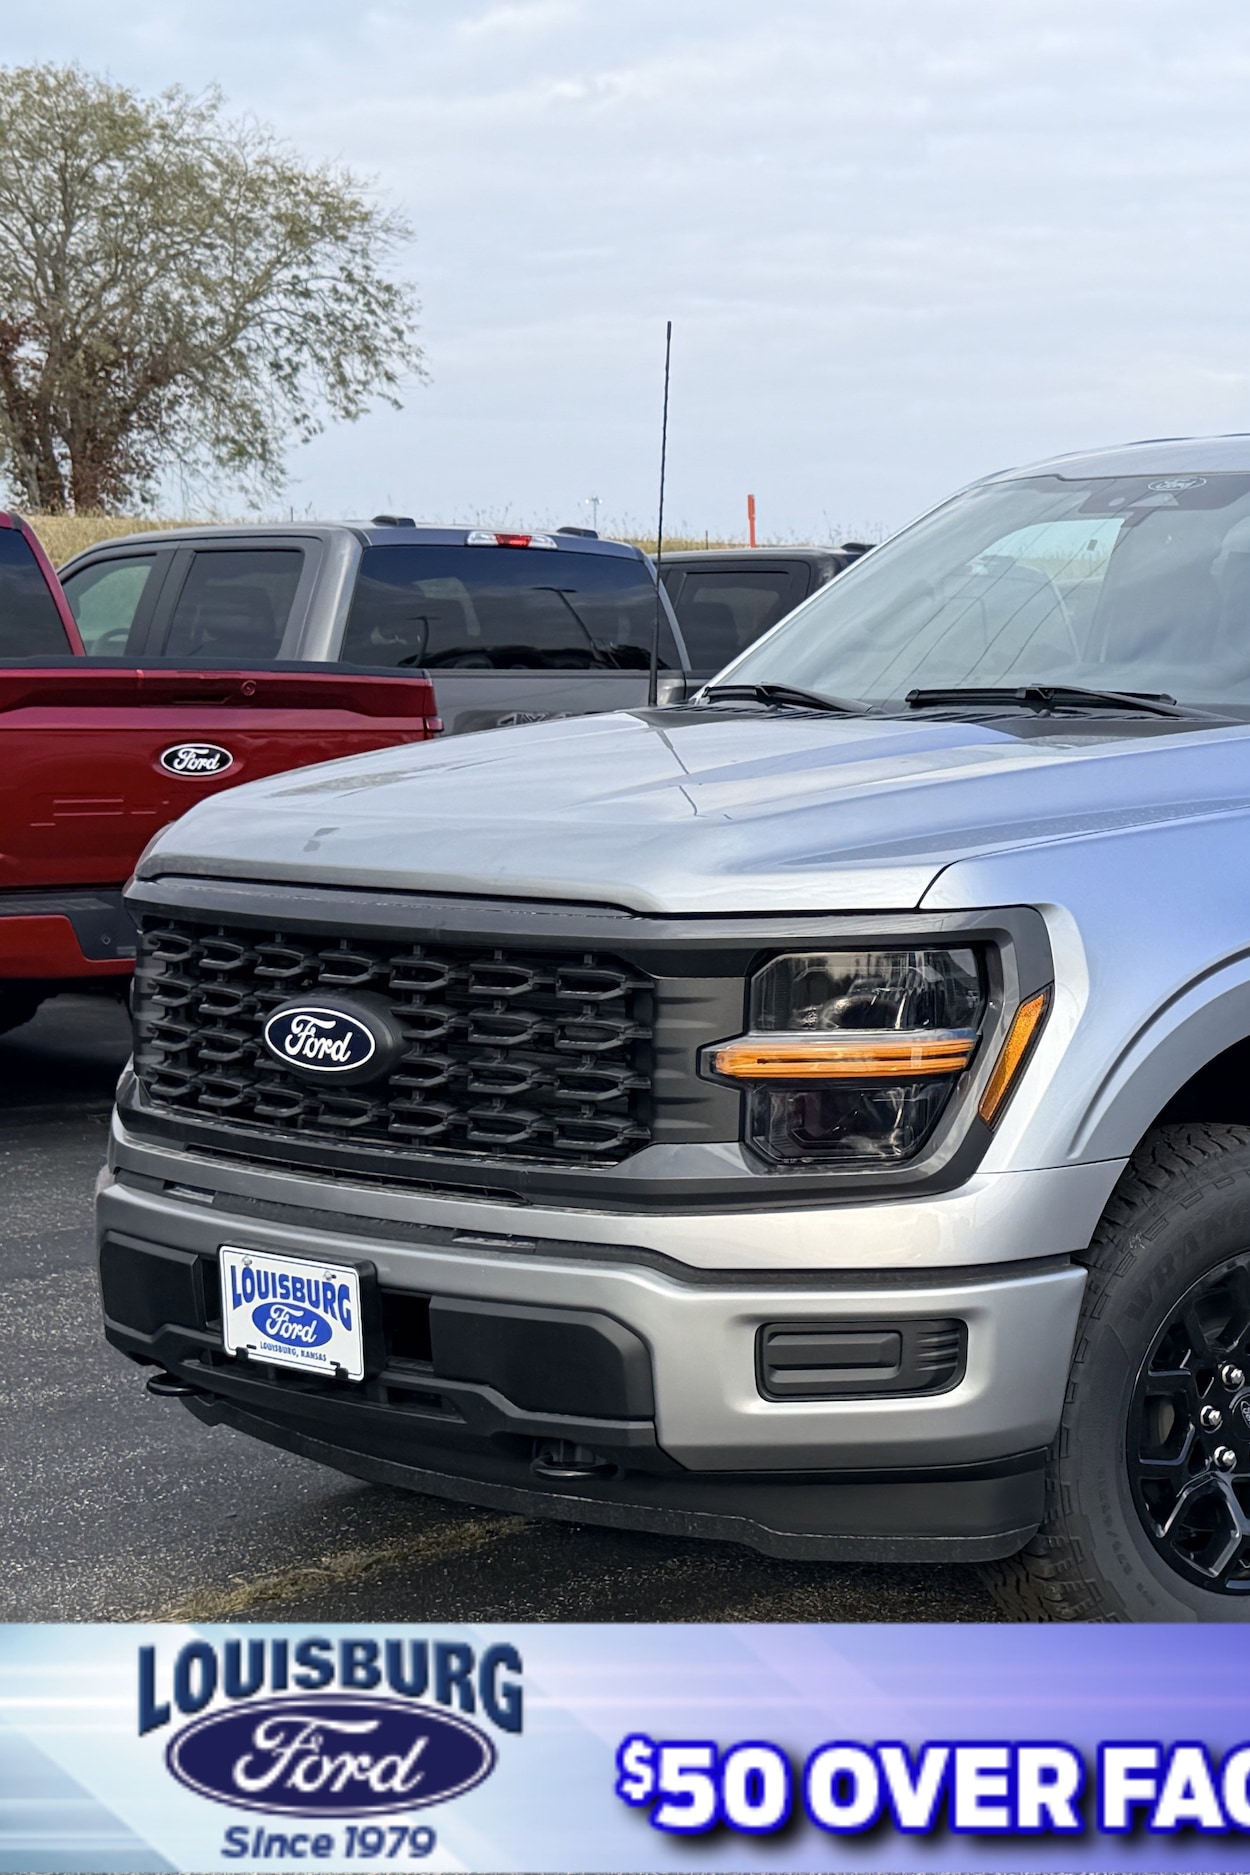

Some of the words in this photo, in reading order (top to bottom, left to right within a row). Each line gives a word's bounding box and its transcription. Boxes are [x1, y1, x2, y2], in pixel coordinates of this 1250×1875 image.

[173, 748, 221, 770] Ford
[285, 1014, 353, 1062] Ford
[230, 1264, 352, 1332] LOUISBURG
[265, 1304, 317, 1343] Ford
[260, 1341, 299, 1358] LOUISBURG,
[300, 1349, 327, 1362] KANSAS
